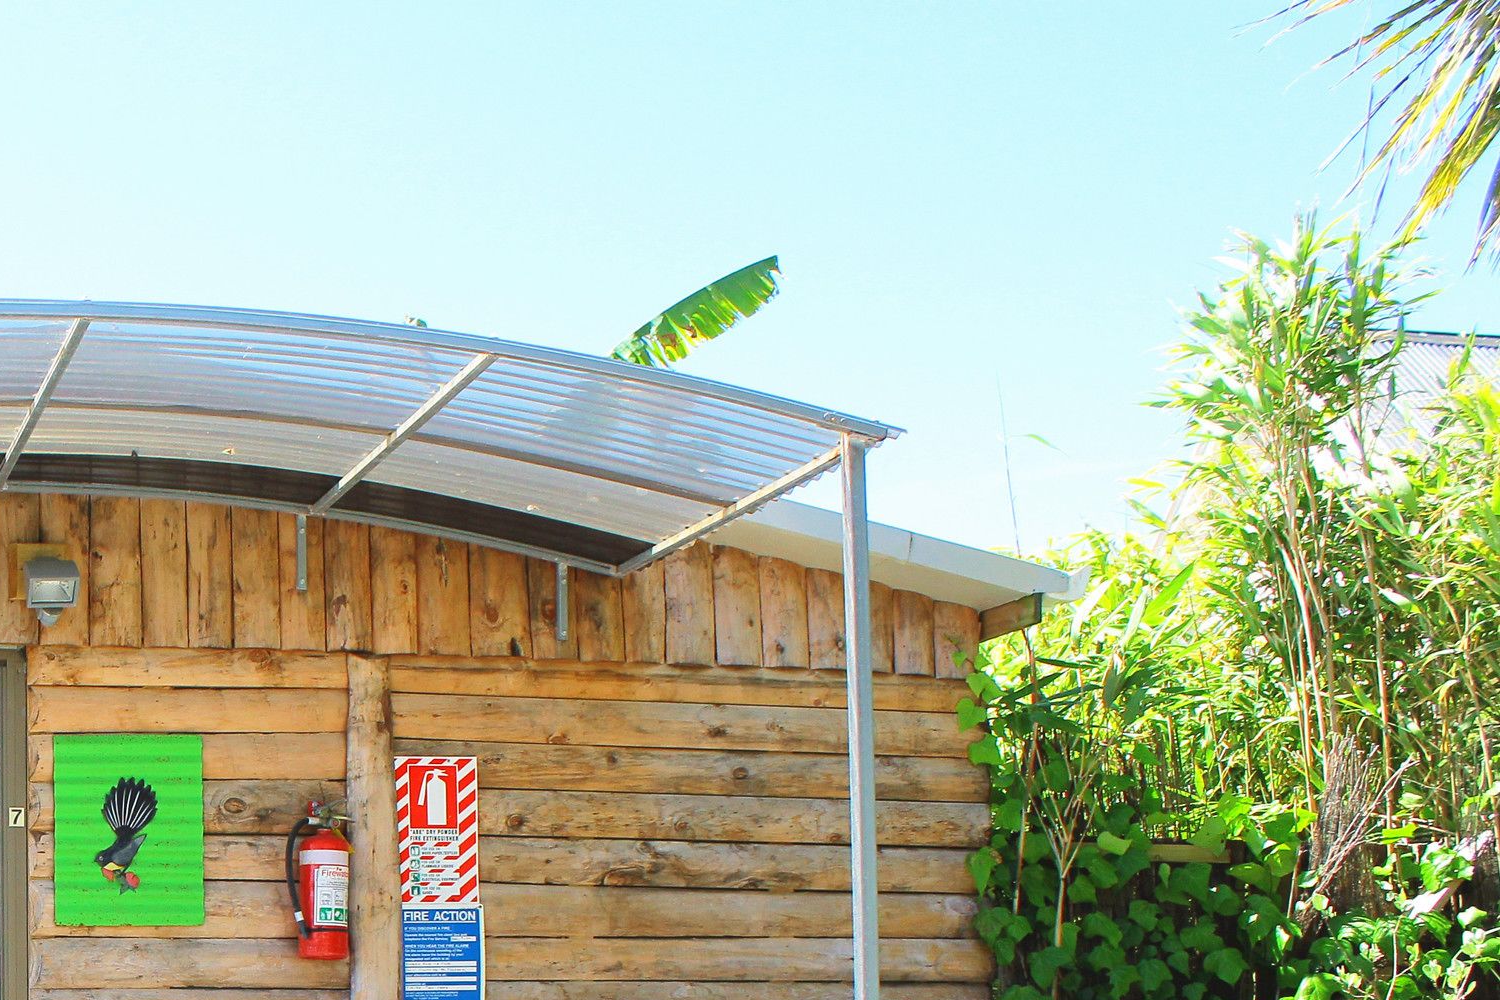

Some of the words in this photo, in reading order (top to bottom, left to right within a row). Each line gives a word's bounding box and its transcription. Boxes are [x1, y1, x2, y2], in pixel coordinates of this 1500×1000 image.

[11, 809, 22, 825] 7
[404, 911, 430, 921] FIRE
[434, 911, 476, 921] ACTION
